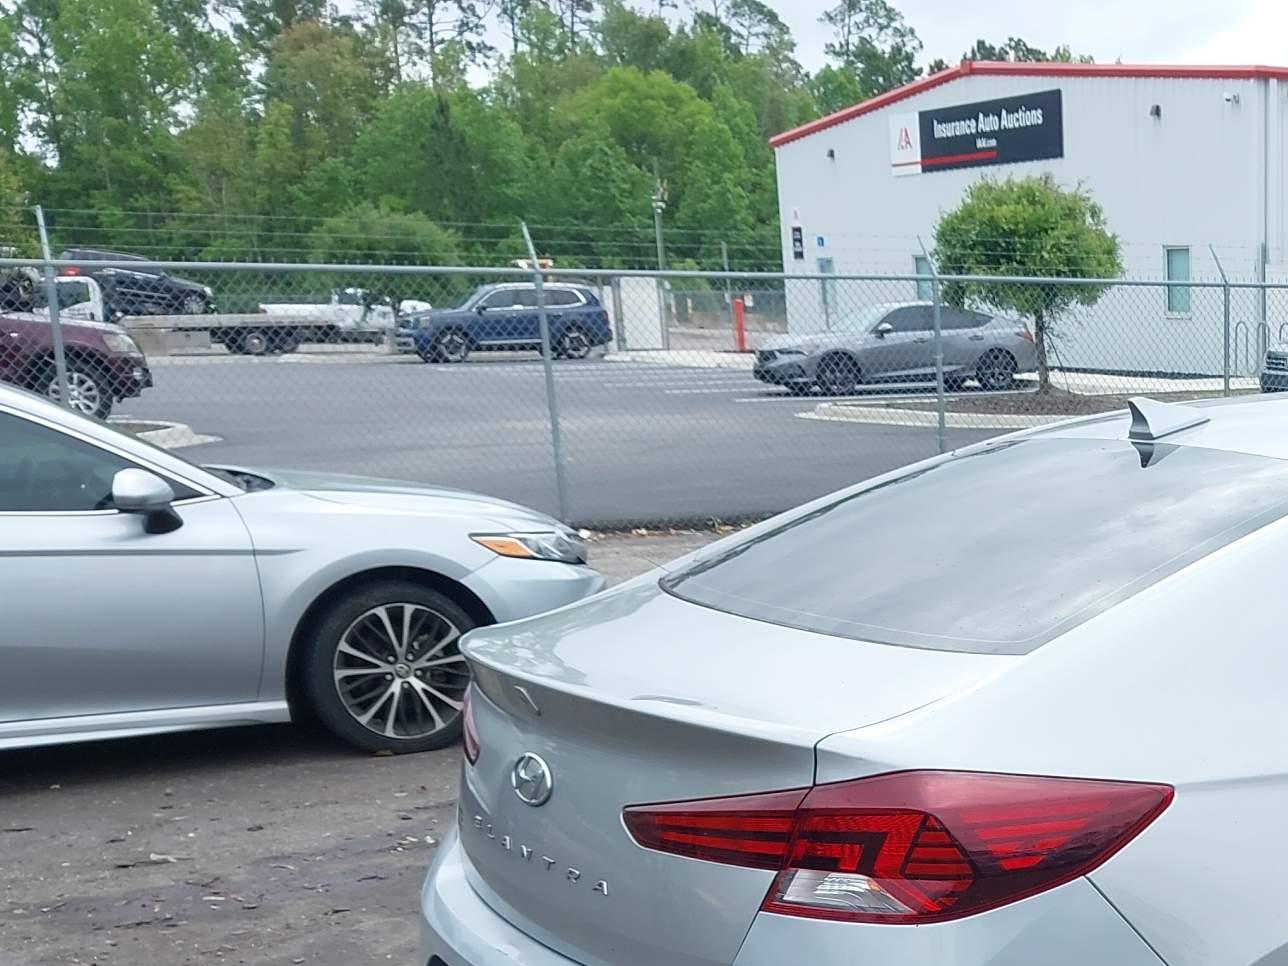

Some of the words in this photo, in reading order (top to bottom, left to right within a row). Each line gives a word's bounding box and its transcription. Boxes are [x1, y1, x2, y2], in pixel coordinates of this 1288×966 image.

[933, 119, 977, 139] Insurance
[977, 111, 1000, 133] Auto
[1000, 105, 1044, 130] Auctions
[474, 814, 608, 896] ELANTRA
